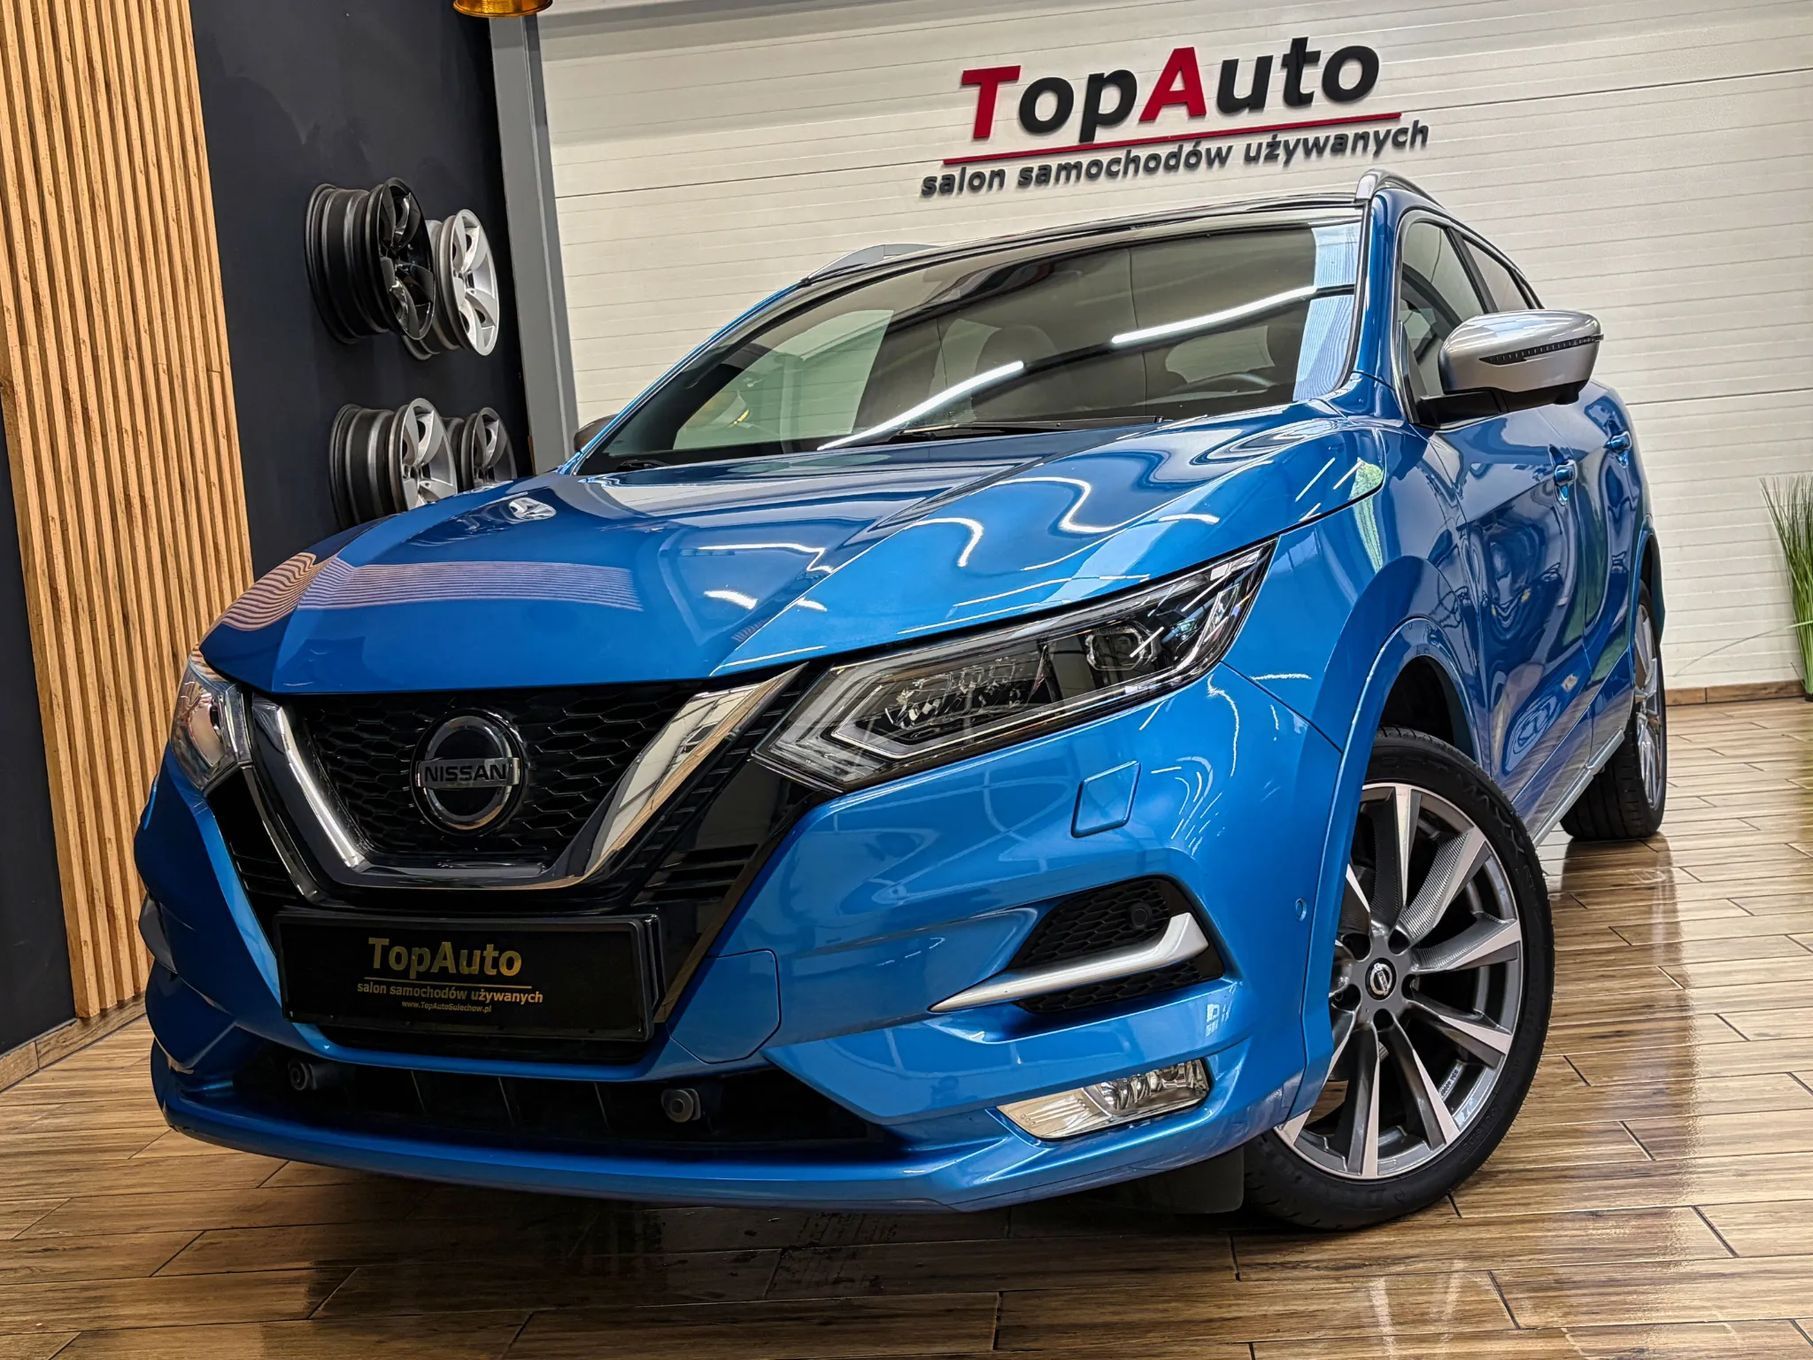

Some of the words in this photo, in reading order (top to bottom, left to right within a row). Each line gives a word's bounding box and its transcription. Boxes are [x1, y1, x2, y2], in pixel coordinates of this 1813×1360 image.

[960, 37, 1380, 143] TopAuto
[921, 166, 1005, 197] salon
[1017, 140, 1235, 187] samochodów
[1244, 120, 1430, 167] używanych
[424, 764, 507, 782] NISSAN
[368, 937, 522, 980] TopAuto
[357, 981, 387, 995] salon
[389, 984, 467, 1000] samochodów
[471, 989, 544, 1005] używanych
